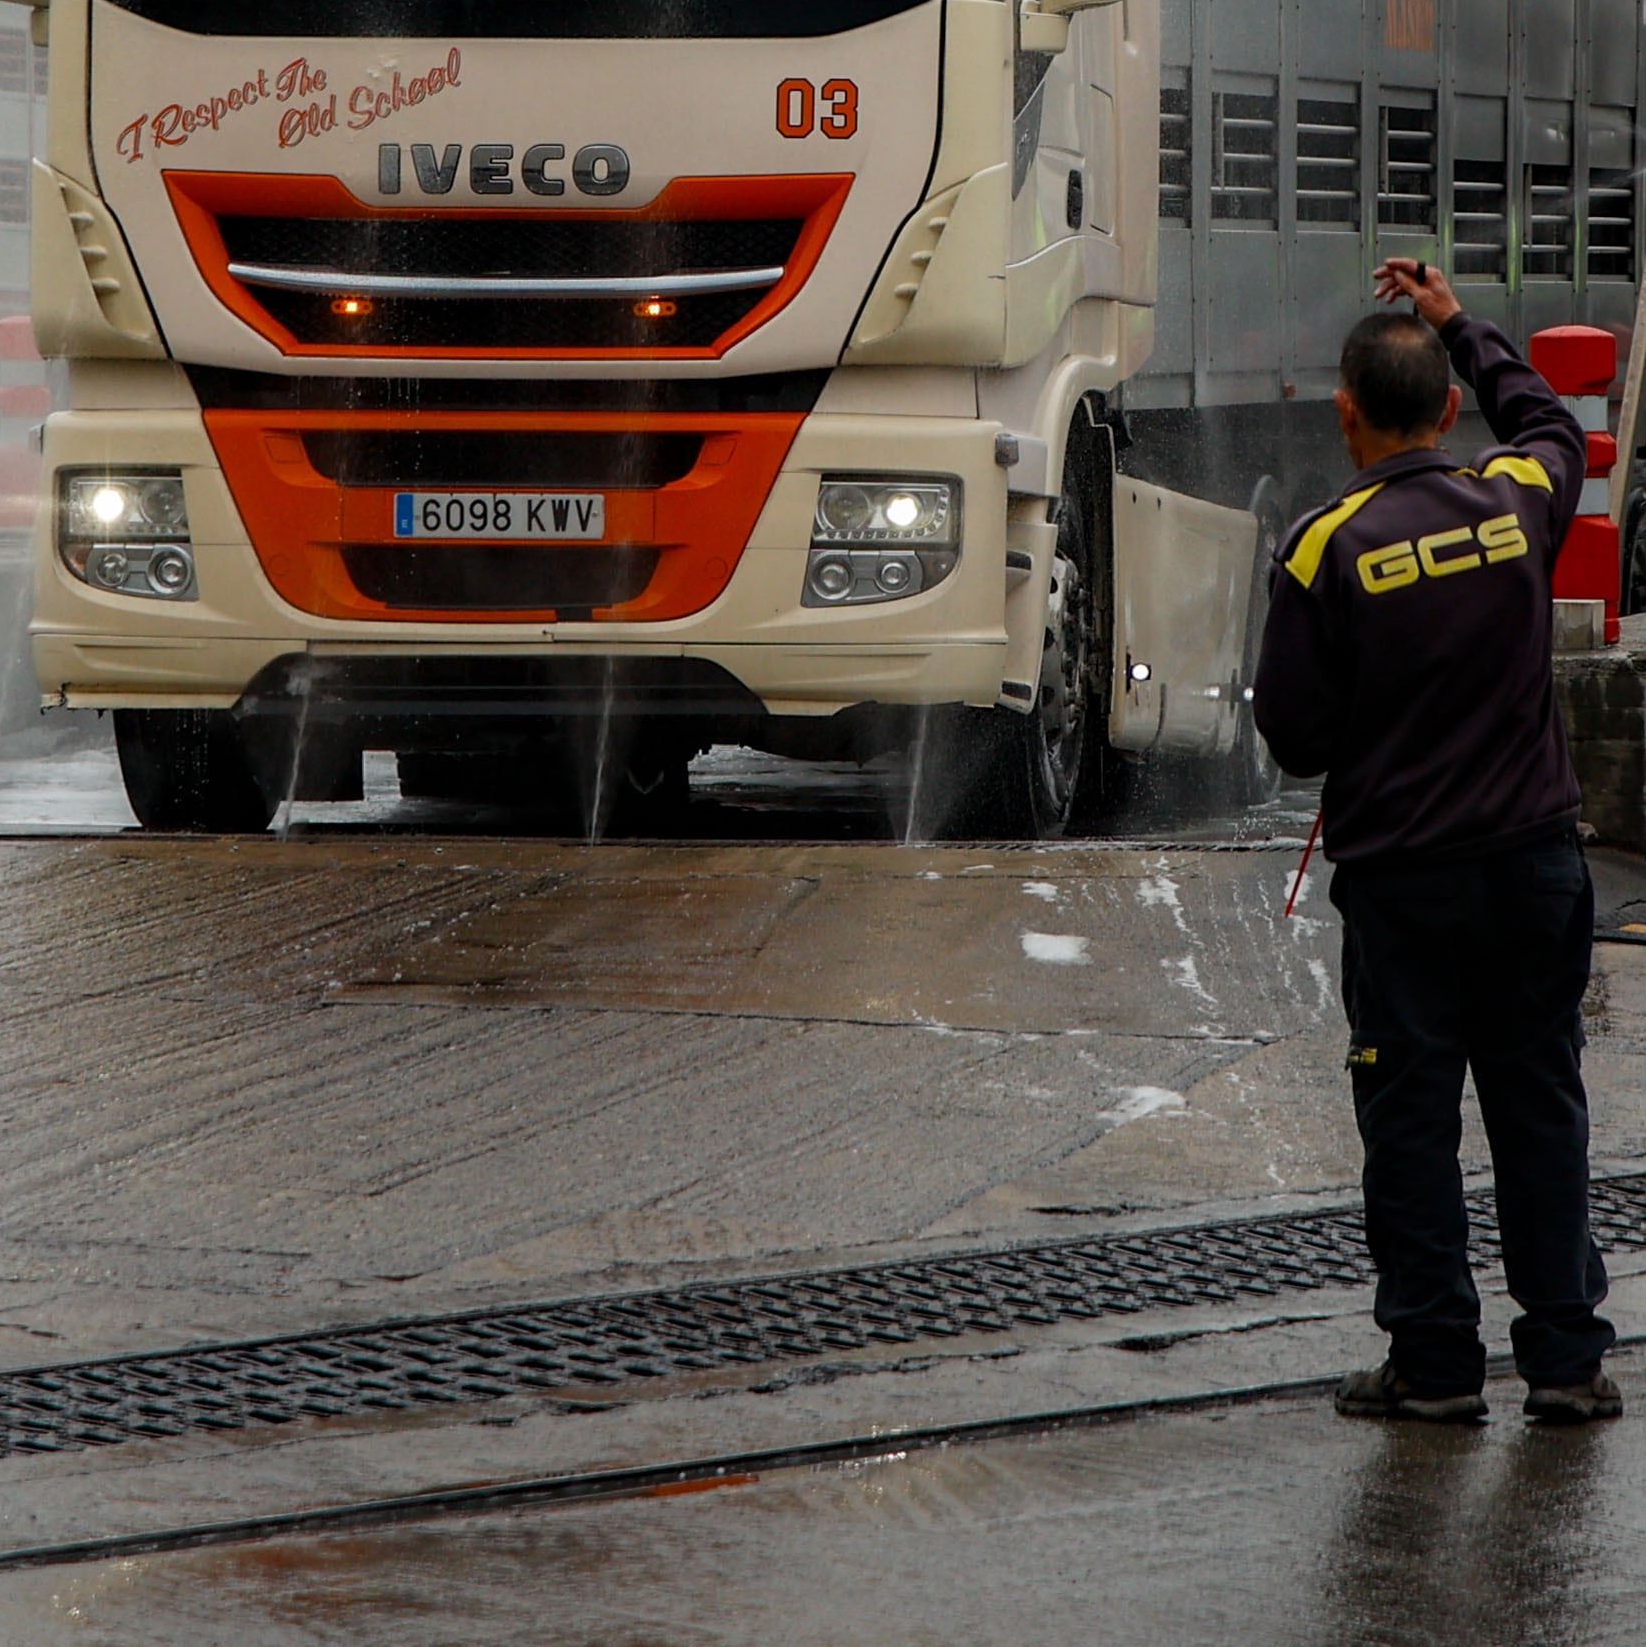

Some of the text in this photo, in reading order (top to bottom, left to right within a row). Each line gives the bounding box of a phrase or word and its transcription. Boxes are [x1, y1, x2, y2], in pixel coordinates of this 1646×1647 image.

[150, 67, 271, 149] Respect
[275, 57, 328, 103] The
[776, 78, 859, 140] 03
[378, 143, 631, 196] IVECO
[422, 499, 593, 532] 6098 KWV
[1356, 513, 1529, 595] GCS
